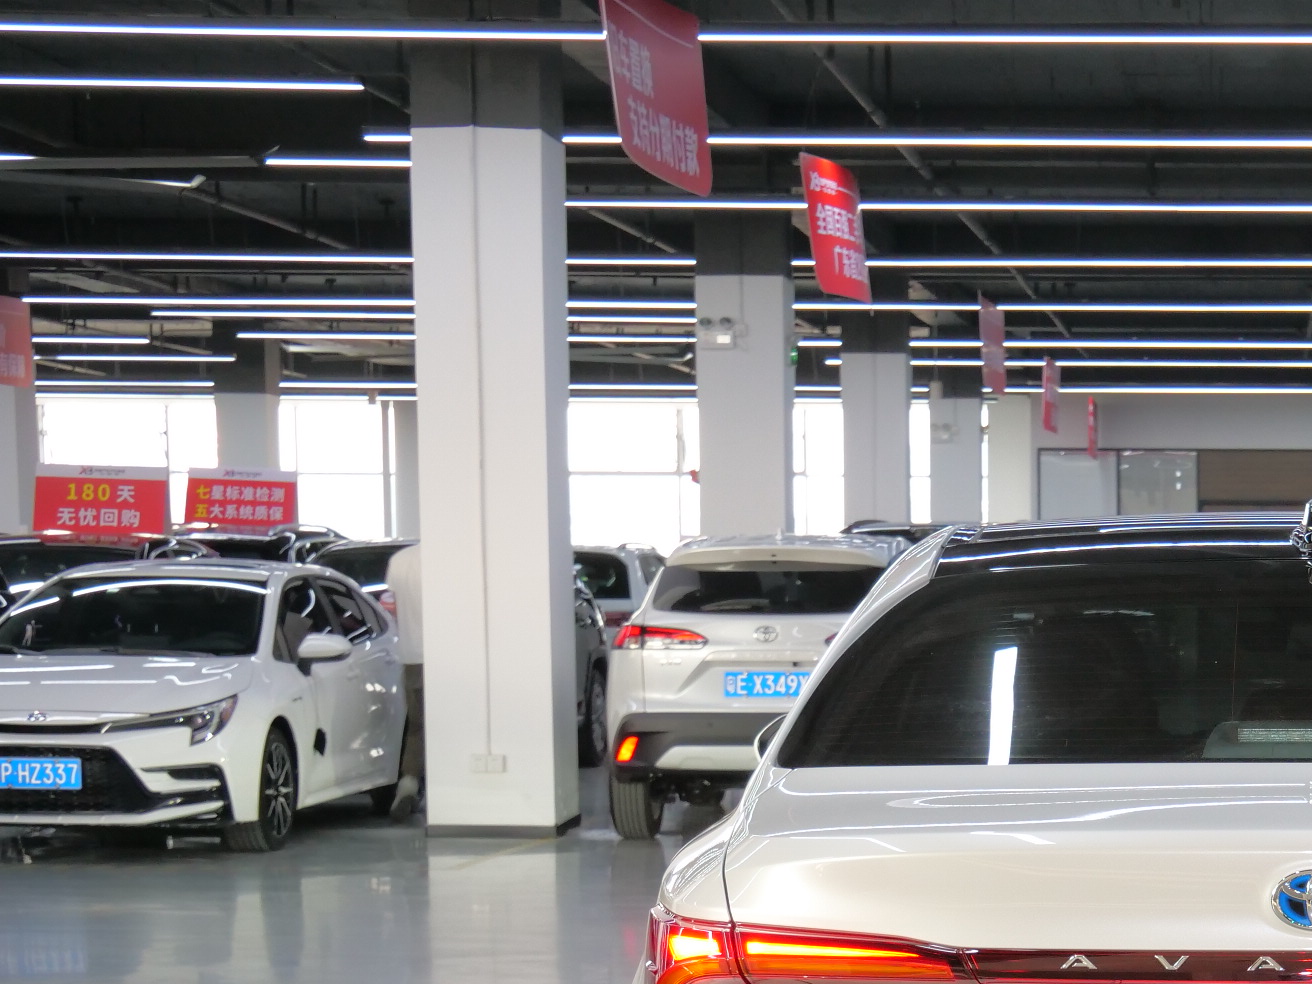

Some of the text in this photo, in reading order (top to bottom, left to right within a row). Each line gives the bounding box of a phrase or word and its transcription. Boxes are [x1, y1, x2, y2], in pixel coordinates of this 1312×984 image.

[627, 94, 699, 177] 支持分期付款
[66, 483, 136, 503] 180 天
[196, 484, 285, 502] 七星标准检测
[56, 507, 141, 527] 无忧回购
[194, 503, 284, 521] 五大系统质保
